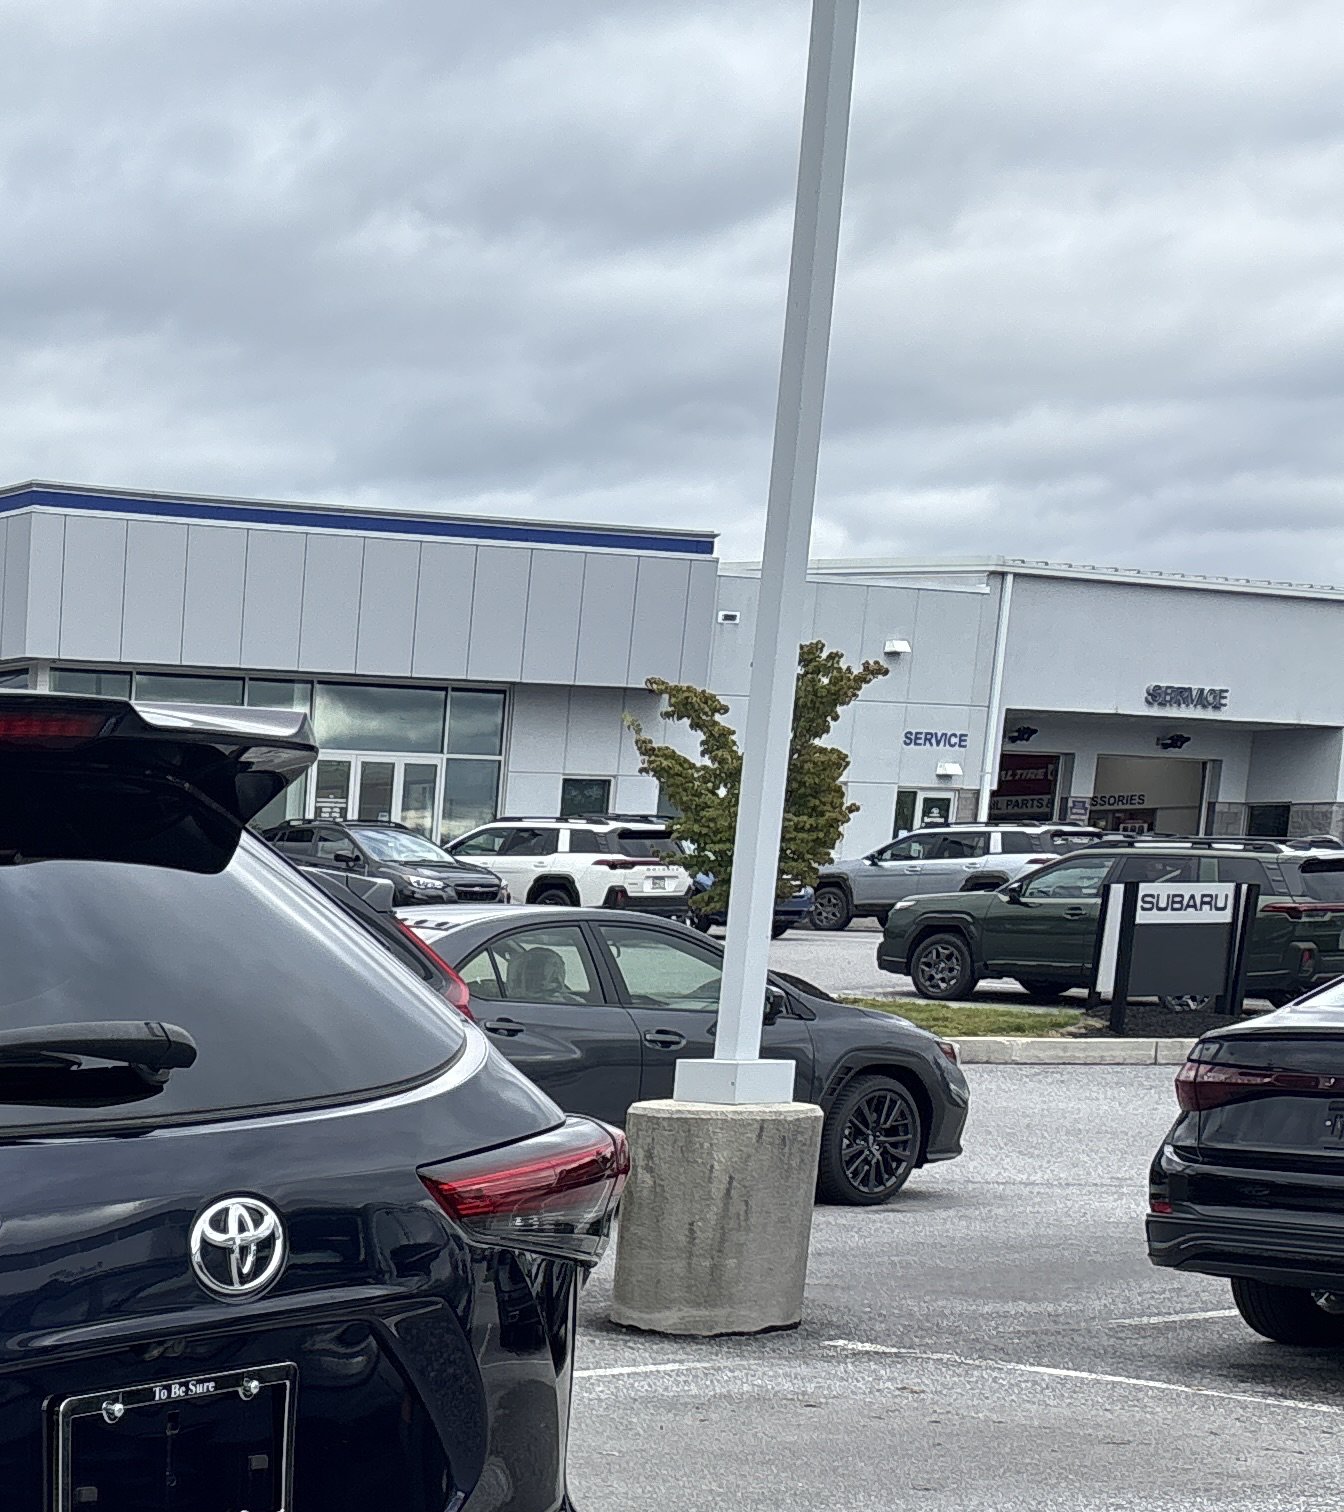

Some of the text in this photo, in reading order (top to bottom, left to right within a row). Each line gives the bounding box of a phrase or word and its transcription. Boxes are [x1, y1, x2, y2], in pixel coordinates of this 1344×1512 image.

[1145, 684, 1230, 709] SERVICE
[903, 731, 969, 749] SERVICE
[1015, 768, 1046, 780] TIRE
[1006, 798, 1044, 810] PARTS
[1140, 893, 1229, 911] SUBARU
[153, 1381, 216, 1401] To Be Sure
